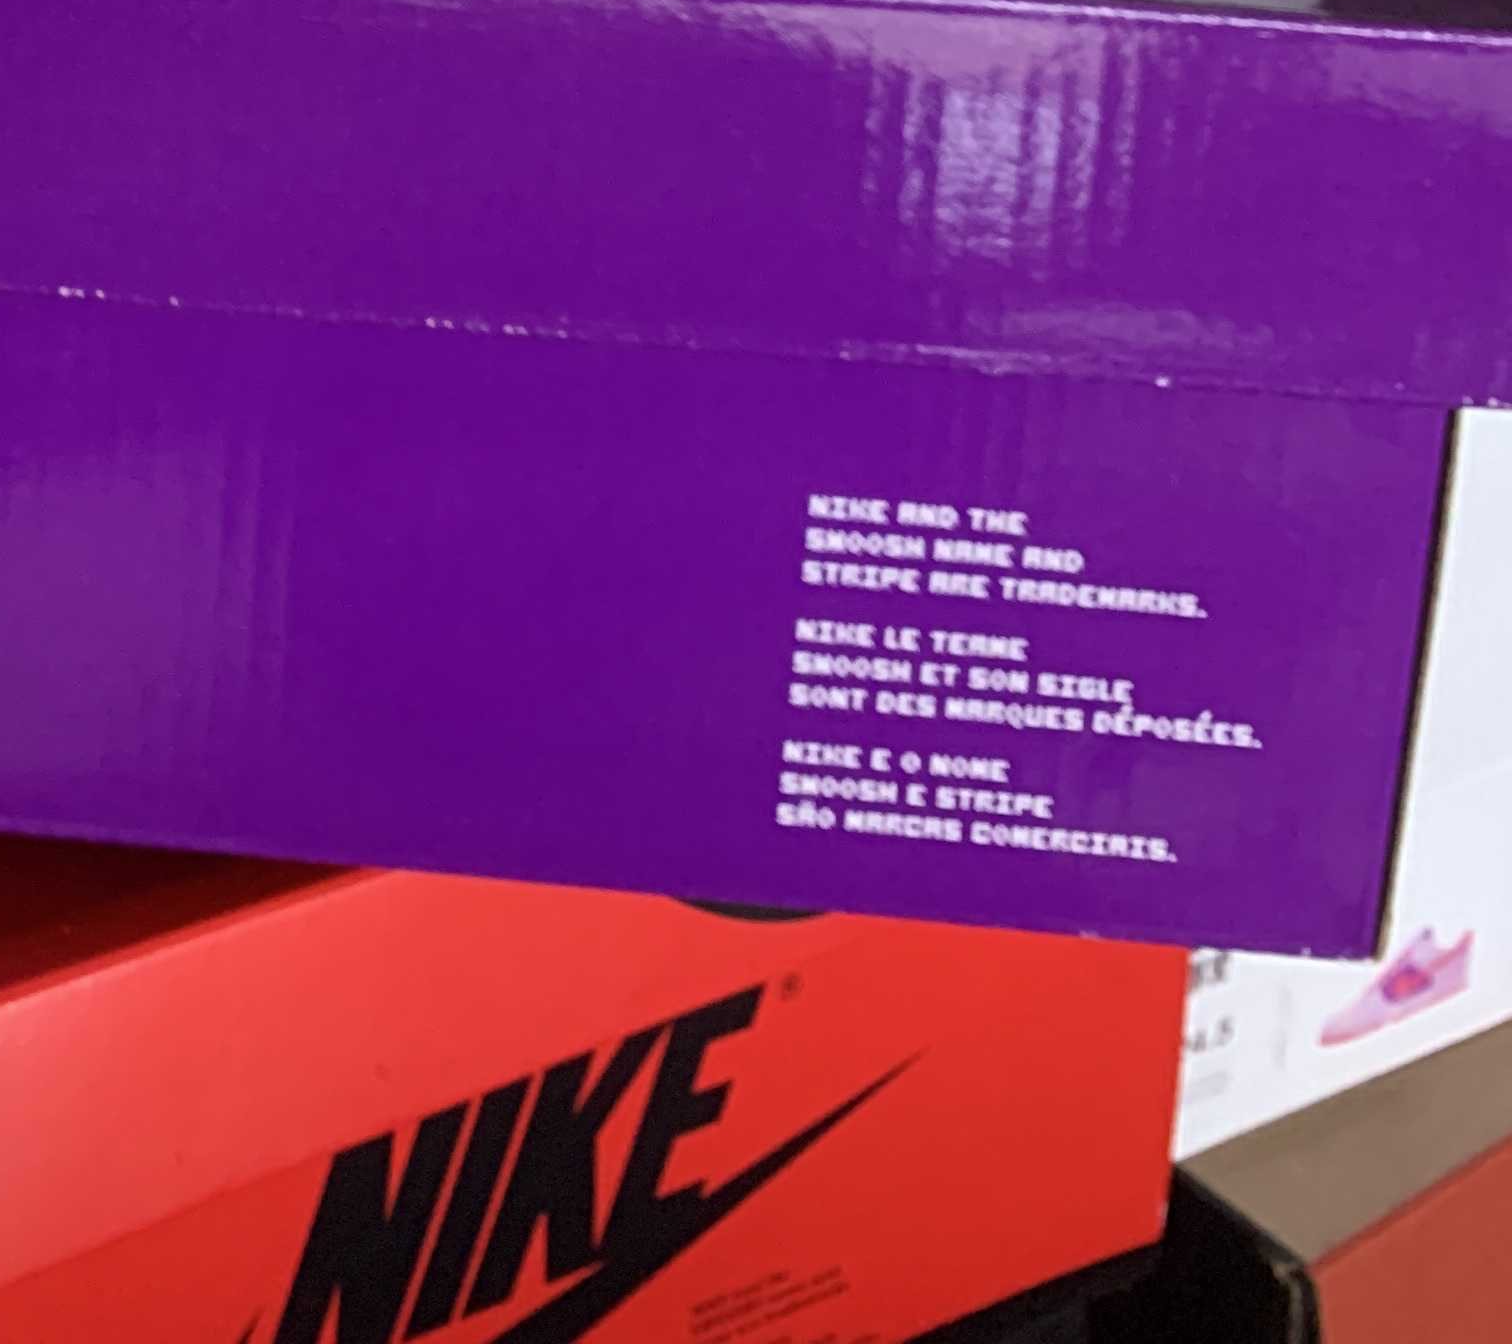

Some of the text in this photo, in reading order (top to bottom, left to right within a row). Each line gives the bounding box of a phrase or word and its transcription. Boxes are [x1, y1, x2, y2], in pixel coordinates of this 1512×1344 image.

[808, 495, 1027, 535] NIKE AND THE
[806, 528, 1084, 573] SWOOSH NAME AND
[802, 560, 1207, 618] STRIPE ARE TRADEMARKS.
[796, 619, 1028, 661] NIKE LE TERME
[792, 651, 1134, 703] SWOOSH ET SON SIGLE
[789, 683, 1262, 748] SONT DES MARQUES DÉPOSÉES.
[783, 740, 1010, 782] NIKE E O NOME
[780, 772, 1053, 818] SWOOSH E STRIPE
[777, 800, 1177, 862] SÃO MARCAS COMERCIAIS.
[276, 981, 767, 1344] NIKE
